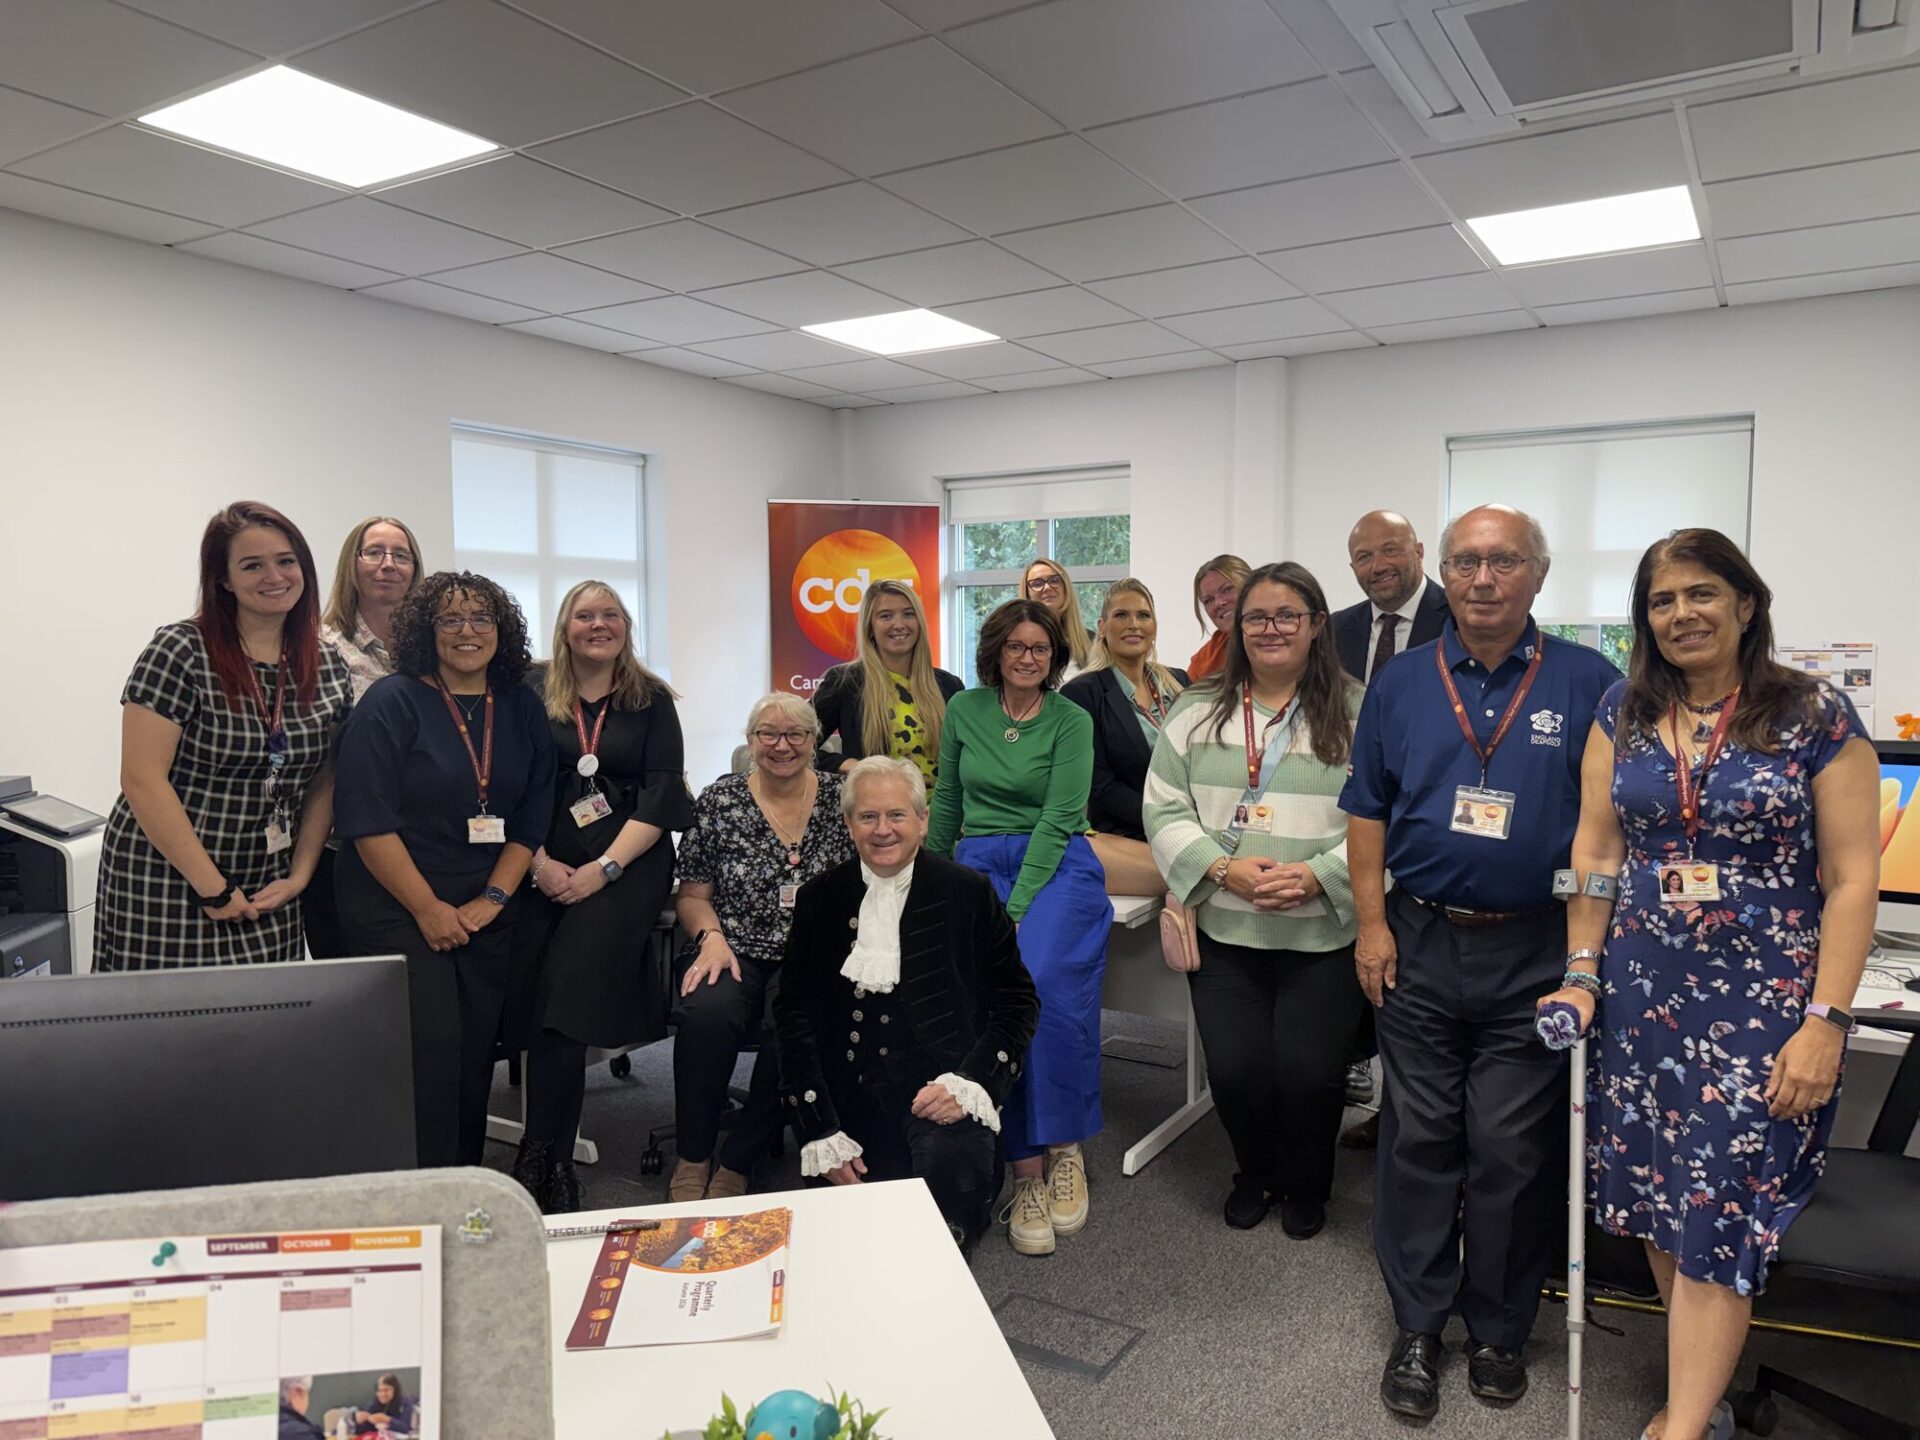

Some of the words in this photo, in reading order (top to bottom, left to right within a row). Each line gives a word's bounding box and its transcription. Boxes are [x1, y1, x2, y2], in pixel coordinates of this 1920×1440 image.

[799, 568, 913, 613] cd
[283, 1239, 332, 1249] OCTOBER
[354, 1236, 411, 1246] NOVEMBER
[210, 1241, 268, 1252] SEPTEMBER
[282, 1280, 294, 1288] 05
[354, 1276, 366, 1284] 06
[209, 1284, 222, 1292] 04
[688, 1281, 705, 1317] Programme
[700, 1280, 717, 1311] Quarterly
